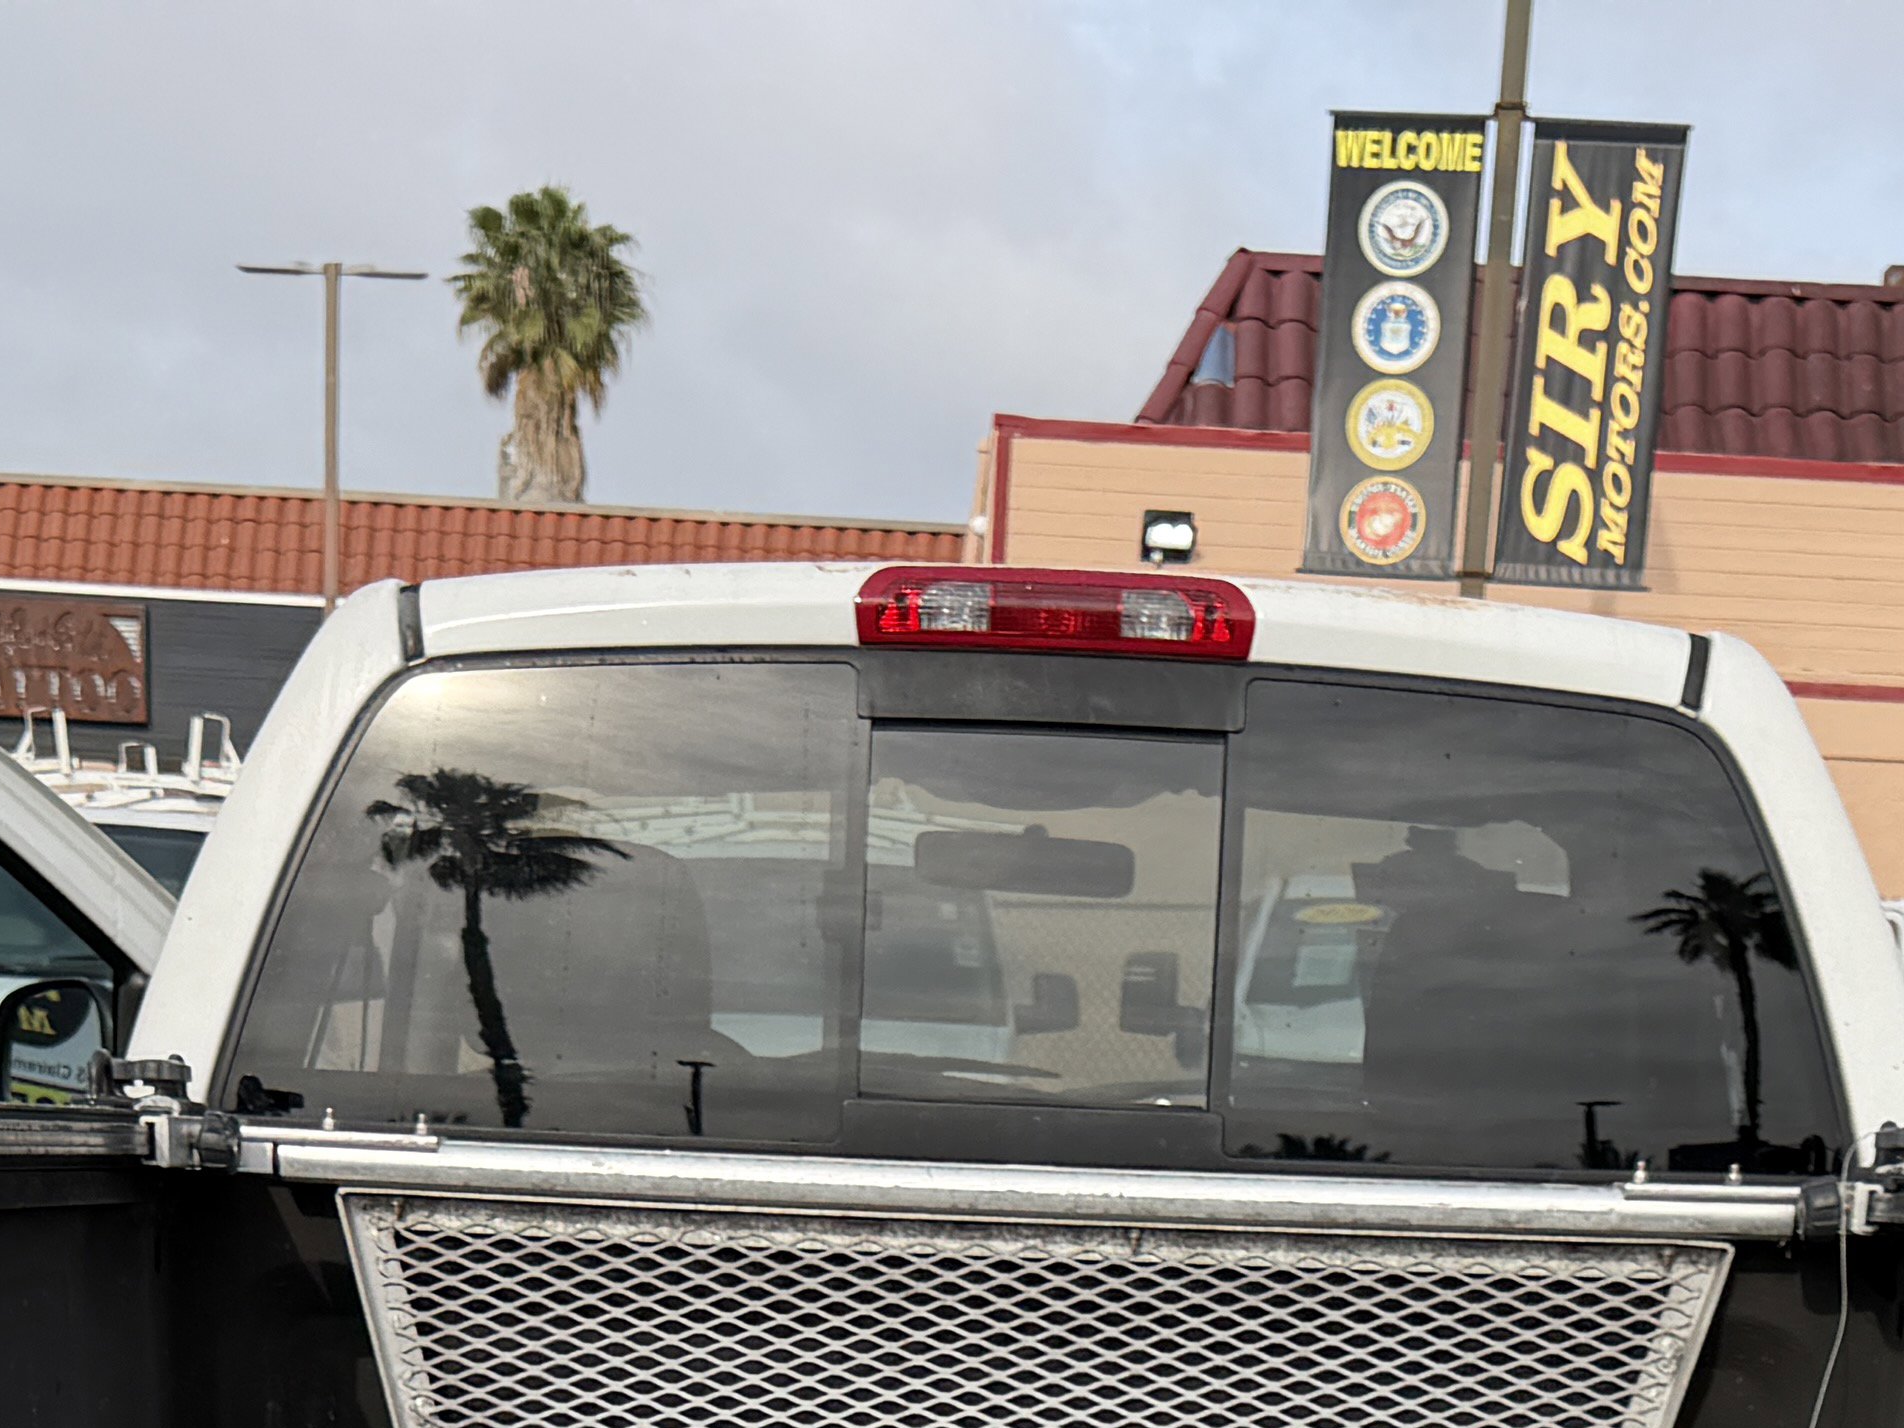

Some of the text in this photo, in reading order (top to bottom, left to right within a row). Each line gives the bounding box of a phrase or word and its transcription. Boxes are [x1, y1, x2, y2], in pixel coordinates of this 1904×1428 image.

[1334, 129, 1484, 172] WELCOME
[1521, 139, 1622, 565] SIRY
[1597, 146, 1664, 565] MOTORS.COM
